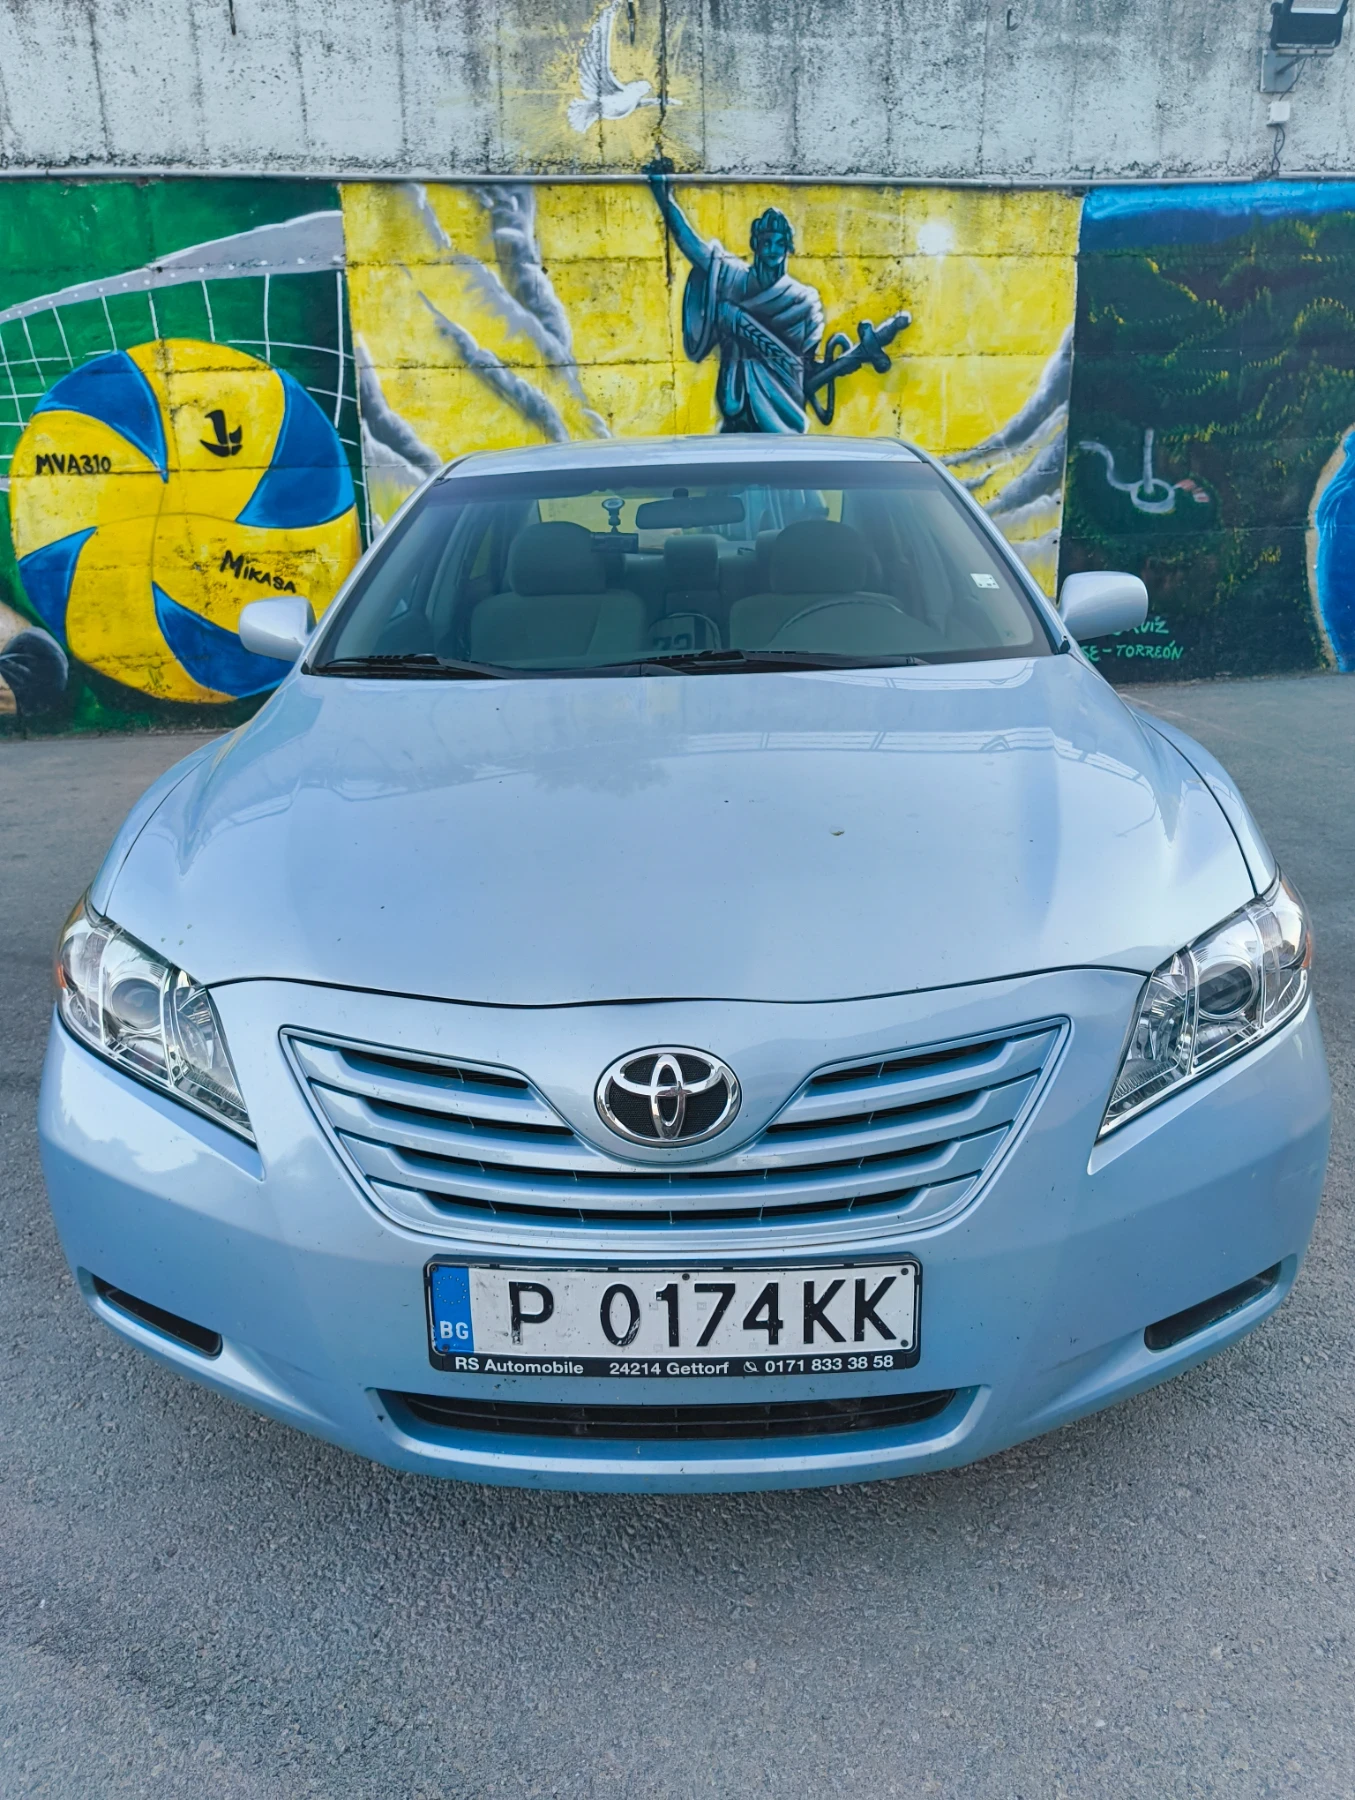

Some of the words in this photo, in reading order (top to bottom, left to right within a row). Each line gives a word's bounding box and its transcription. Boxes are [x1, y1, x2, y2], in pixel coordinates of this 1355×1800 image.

[36, 453, 111, 476] MVA310
[509, 1280, 554, 1345] P
[440, 1320, 469, 1340] BG
[455, 1357, 479, 1371] RS
[485, 1359, 584, 1374] Automobile
[609, 1363, 661, 1375] 24214
[667, 1362, 729, 1375] Gettorf
[765, 1360, 804, 1373] 0171
[811, 1358, 842, 1371] 833
[848, 1357, 868, 1370] 38
[873, 1355, 894, 1368] 58
